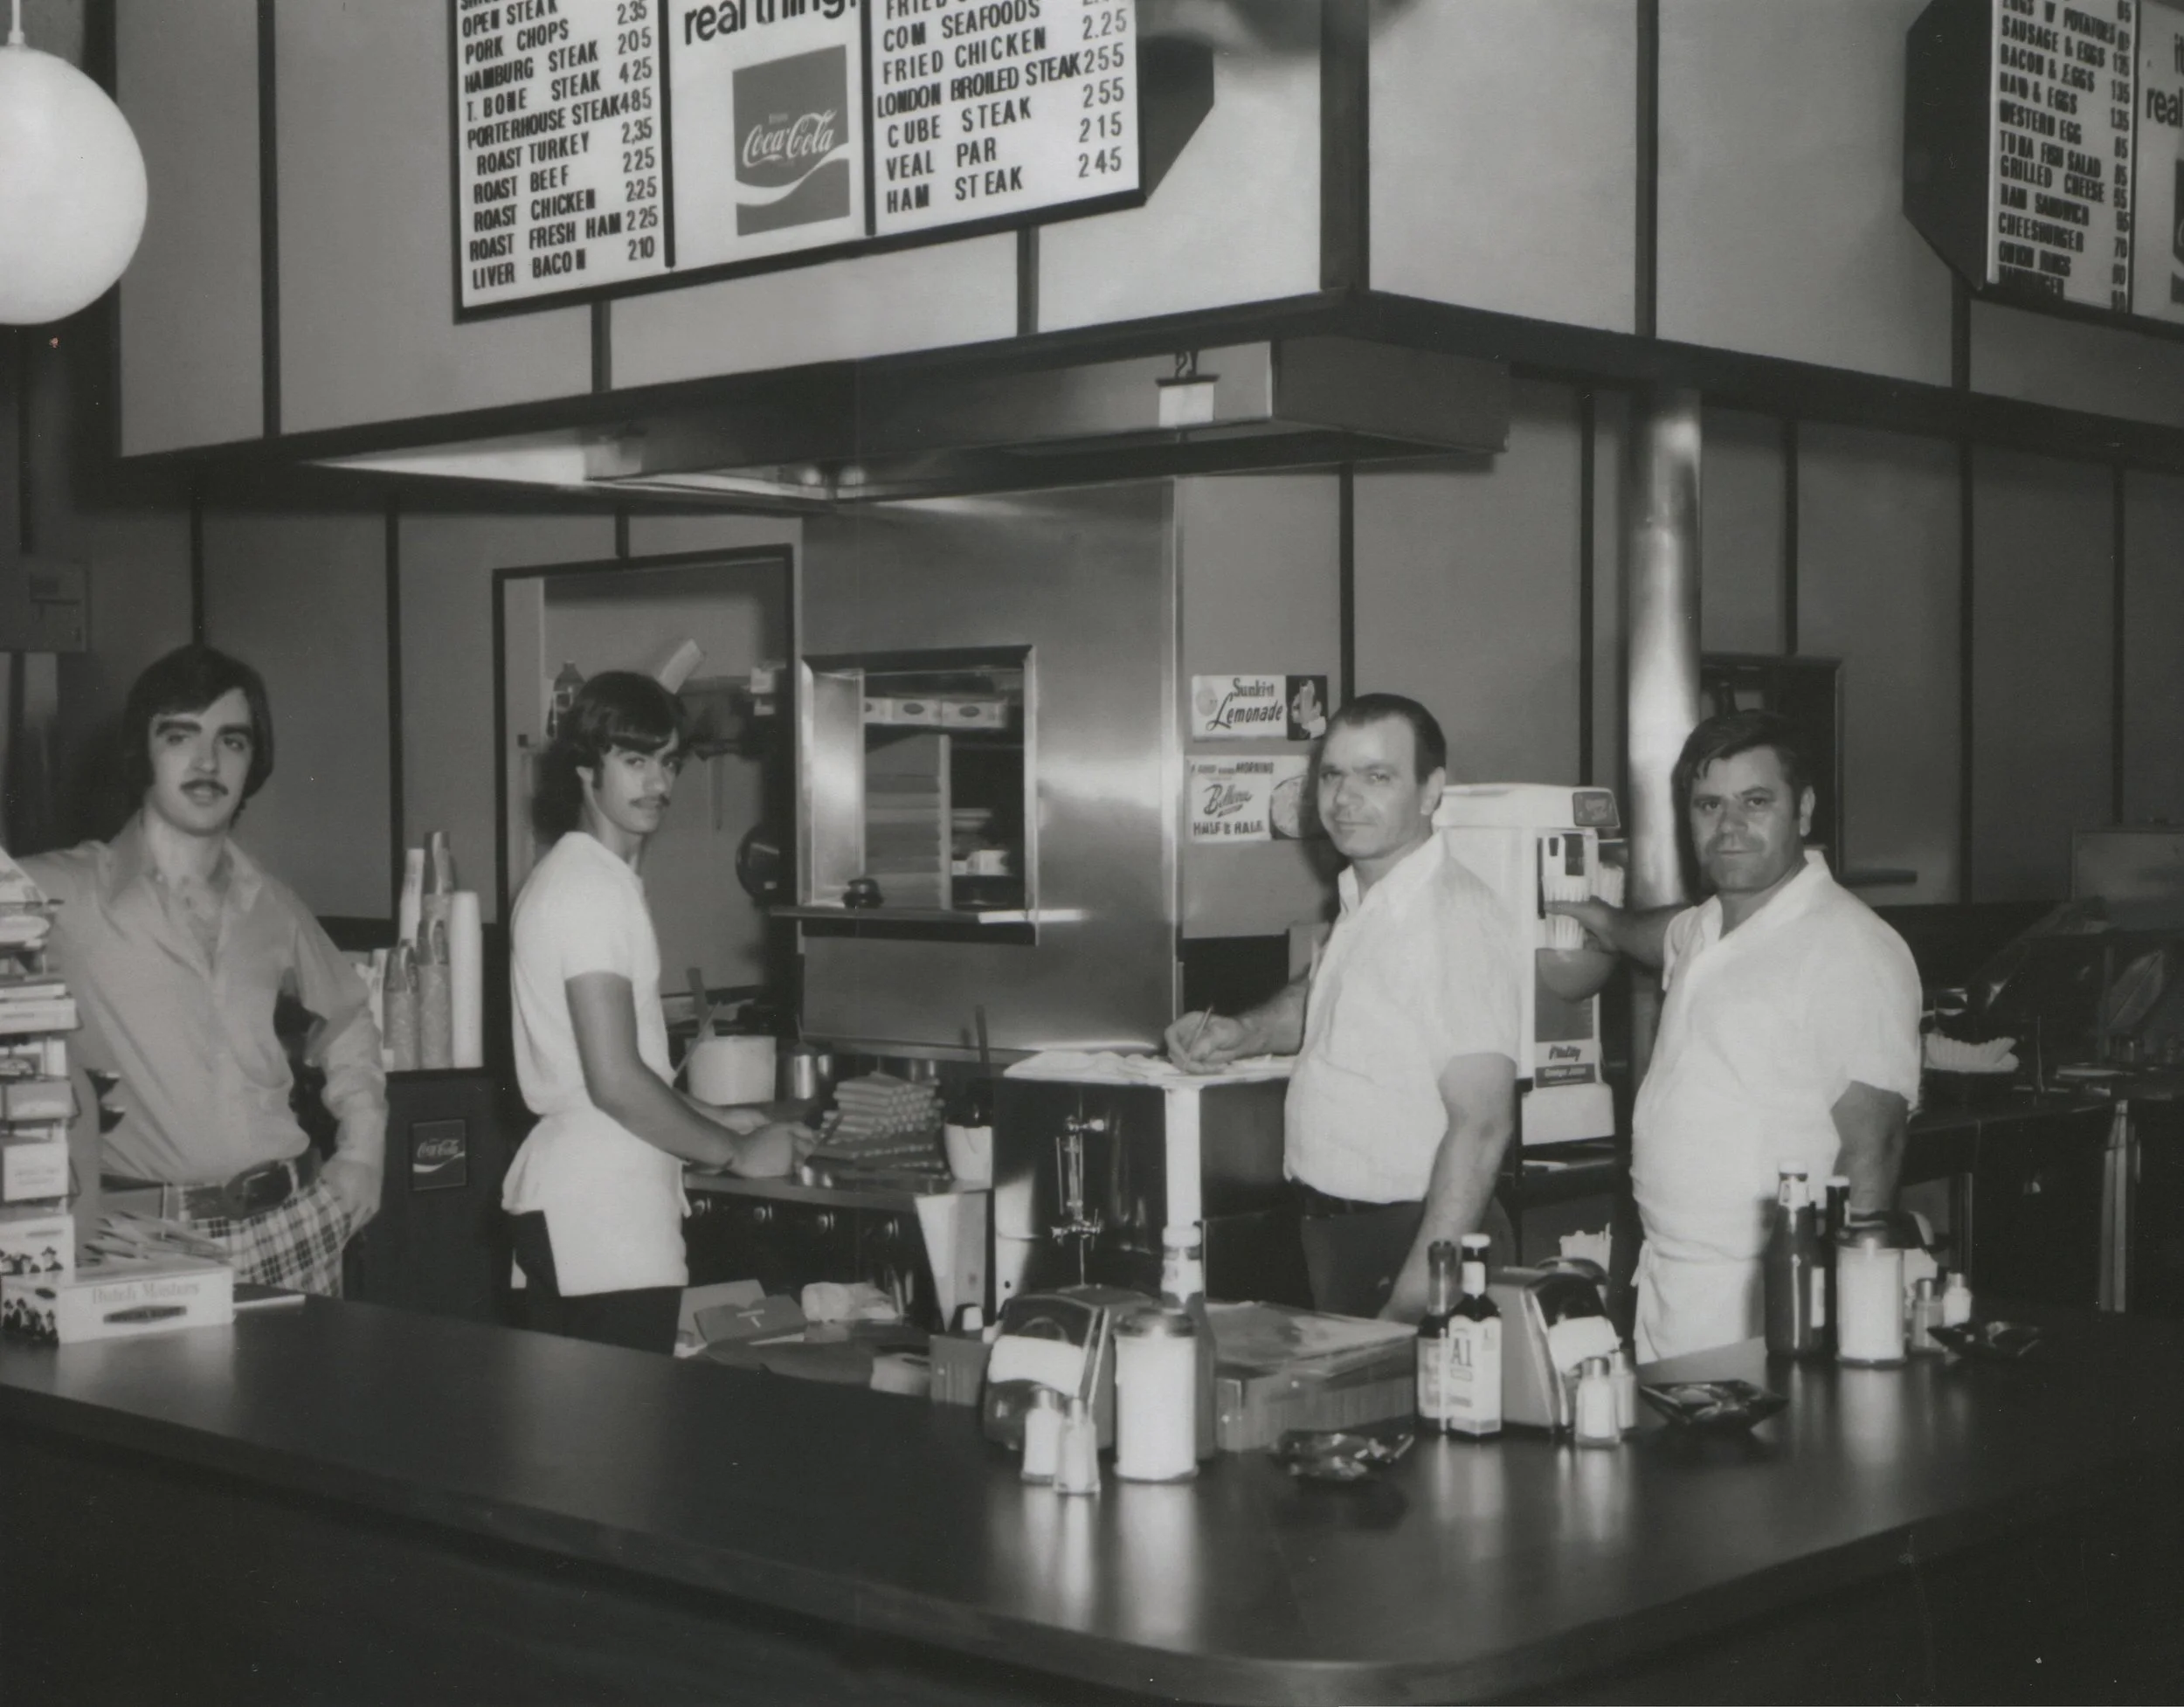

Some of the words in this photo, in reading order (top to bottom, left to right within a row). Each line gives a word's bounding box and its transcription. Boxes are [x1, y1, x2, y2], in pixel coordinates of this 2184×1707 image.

[463, 12, 500, 38] OPEN
[506, 0, 558, 24] STEAK
[466, 36, 503, 65] PORK
[517, 18, 569, 51] CHOPS
[684, 2, 747, 45] real
[942, 0, 1040, 38] SEAFOODS
[2002, 15, 2058, 52] SAUSAGE
[465, 57, 534, 93] HAMBURG
[549, 40, 598, 72] STEAK
[618, 26, 652, 55] 205
[882, 50, 943, 84] FRIED
[955, 26, 1047, 68] CHICKEN
[1082, 8, 1127, 40] 2.25
[2001, 44, 2044, 75] BACON
[483, 87, 528, 118] BONE
[551, 69, 601, 101] STEAK
[619, 56, 652, 84] 425
[878, 82, 942, 117] LONDON
[950, 66, 1019, 100] BROILED
[1026, 51, 1082, 86] STEAK
[1083, 42, 1124, 73] 255
[467, 107, 566, 149] PORTERHOUSE
[572, 93, 621, 125] STEAK
[620, 86, 652, 112] 485
[888, 114, 942, 148] CUBE
[961, 96, 1032, 132] STEAK
[1082, 77, 1124, 108] 255
[2000, 100, 2056, 136] WESTERN
[477, 146, 523, 176] ROAST
[529, 130, 590, 163] TURKEY
[886, 149, 935, 181] VEAL
[957, 136, 997, 167] PAR
[1079, 111, 1123, 142] 215
[2000, 132, 2034, 159] TUNA
[2068, 150, 2101, 177] SALAD
[474, 175, 518, 204] ROAST
[530, 164, 569, 192] BEEF
[623, 147, 655, 173] 225
[887, 183, 930, 213] HAM
[955, 166, 1023, 200] STEAK
[1078, 147, 1122, 178] 245
[2001, 155, 2052, 188] GRILLED
[2064, 173, 2105, 203] CHEESE
[470, 232, 515, 261] ROAST
[529, 221, 577, 250] FRESH
[585, 211, 622, 239] HAM
[627, 205, 658, 231] 225
[474, 204, 517, 232] ROAST
[531, 188, 596, 220] CHICKEN
[473, 261, 515, 290] LIVER
[532, 248, 586, 279] BACON
[628, 236, 655, 261] 210
[1206, 692, 1283, 731] Lemonade
